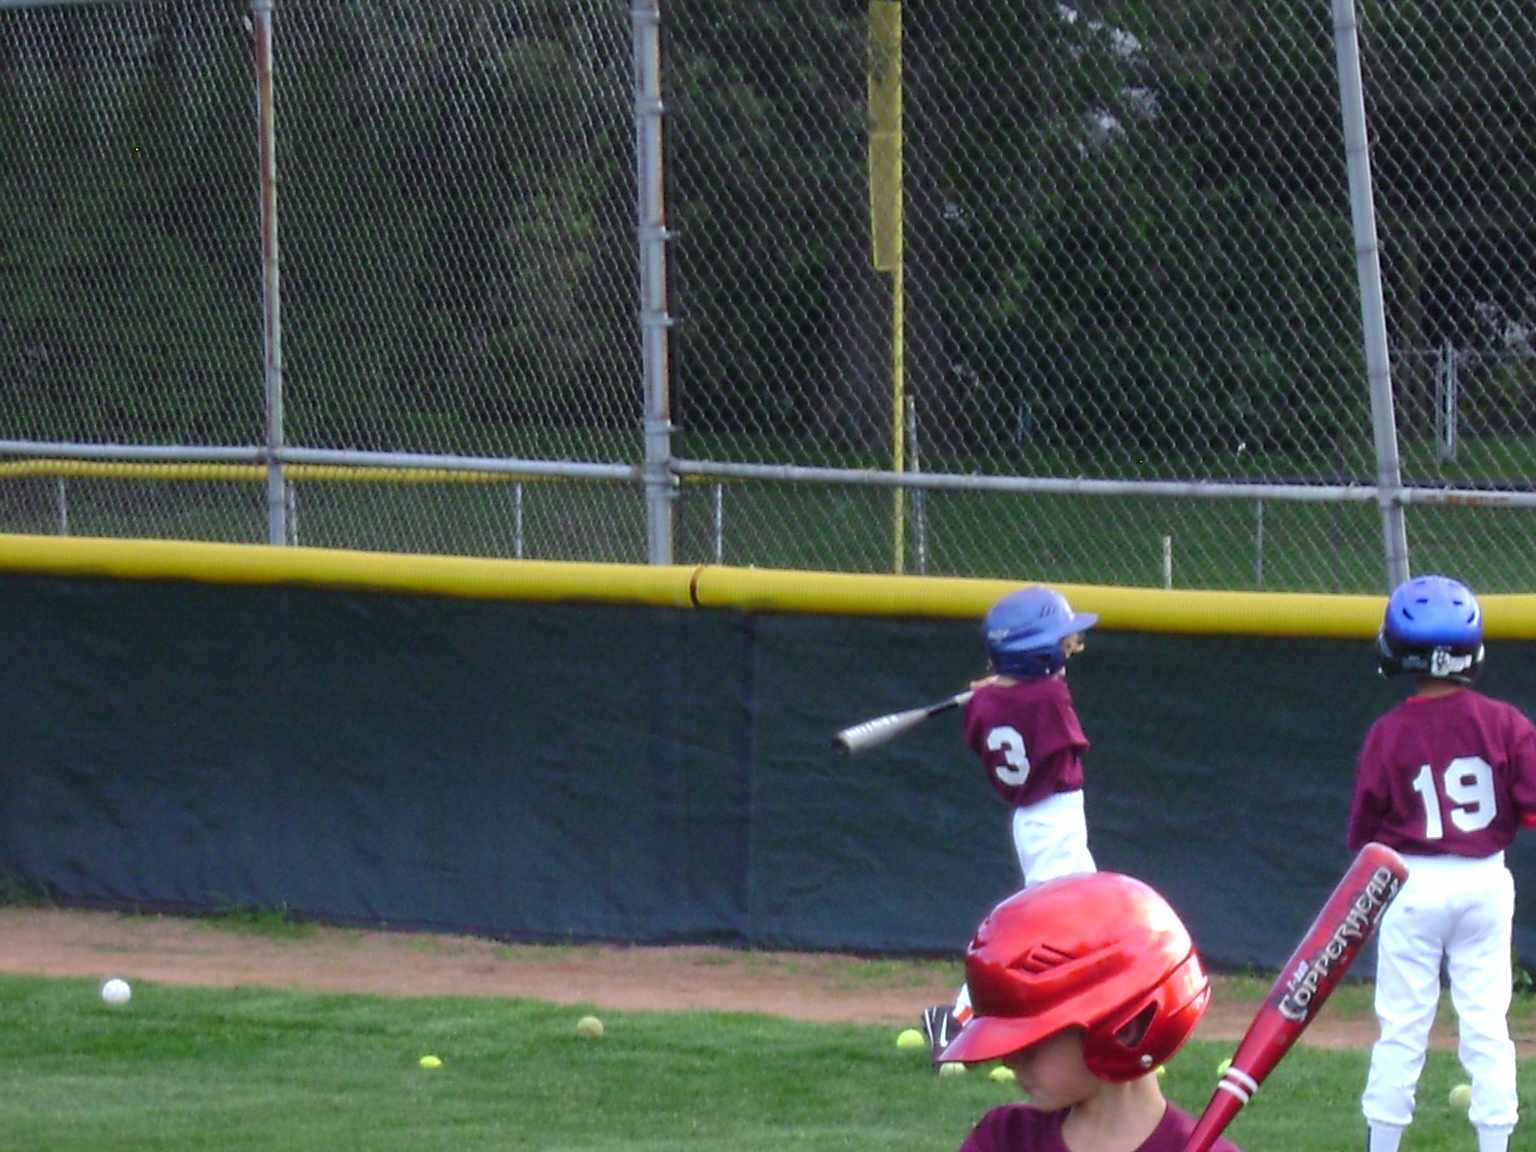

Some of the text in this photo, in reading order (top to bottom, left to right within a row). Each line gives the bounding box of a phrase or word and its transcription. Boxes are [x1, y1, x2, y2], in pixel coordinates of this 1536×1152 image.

[986, 725, 1031, 786] 3
[1412, 755, 1498, 840] 19
[1278, 865, 1395, 1021] COPPERHEAD
